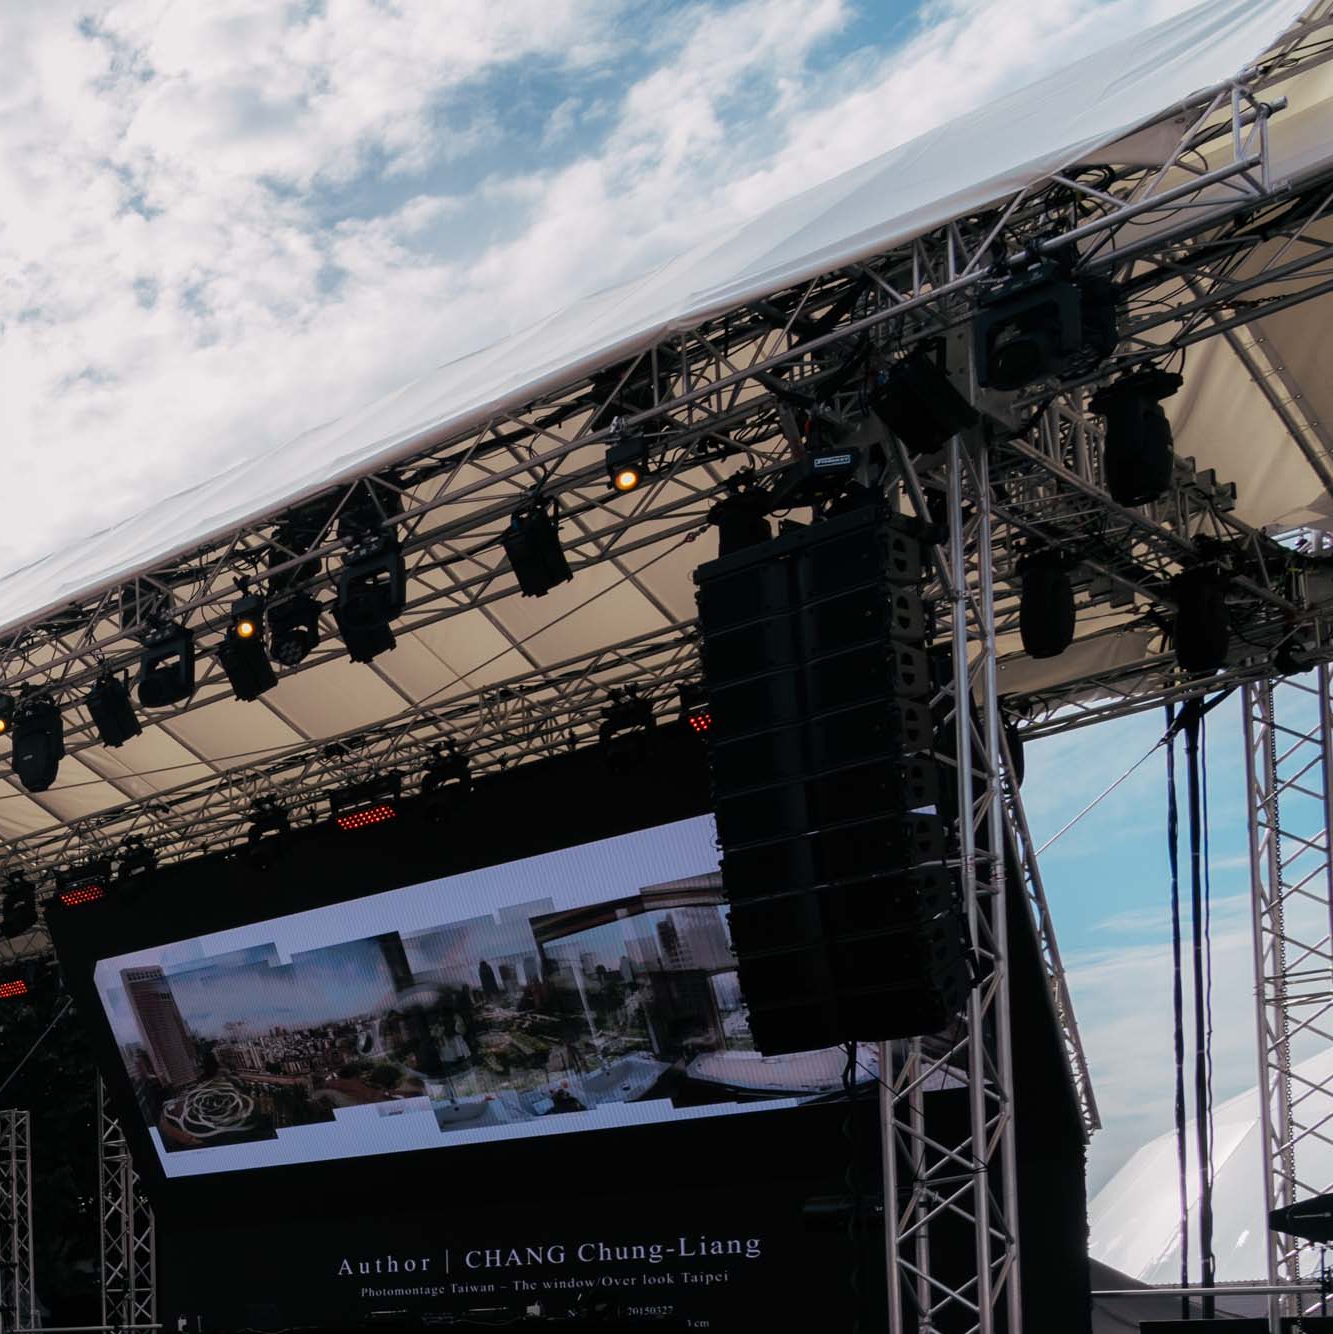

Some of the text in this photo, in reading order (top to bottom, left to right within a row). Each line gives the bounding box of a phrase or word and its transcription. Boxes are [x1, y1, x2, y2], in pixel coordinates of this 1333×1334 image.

[337, 1253, 432, 1276] Author
[465, 1244, 567, 1270] CHANG
[577, 1235, 762, 1264] Chung-Liang
[360, 1283, 446, 1298] Photomontage
[450, 1280, 496, 1294] Taiwan
[513, 1278, 538, 1292] The
[541, 1272, 637, 1291] window/Over
[642, 1271, 676, 1286] look
[682, 1269, 729, 1286] Taipei
